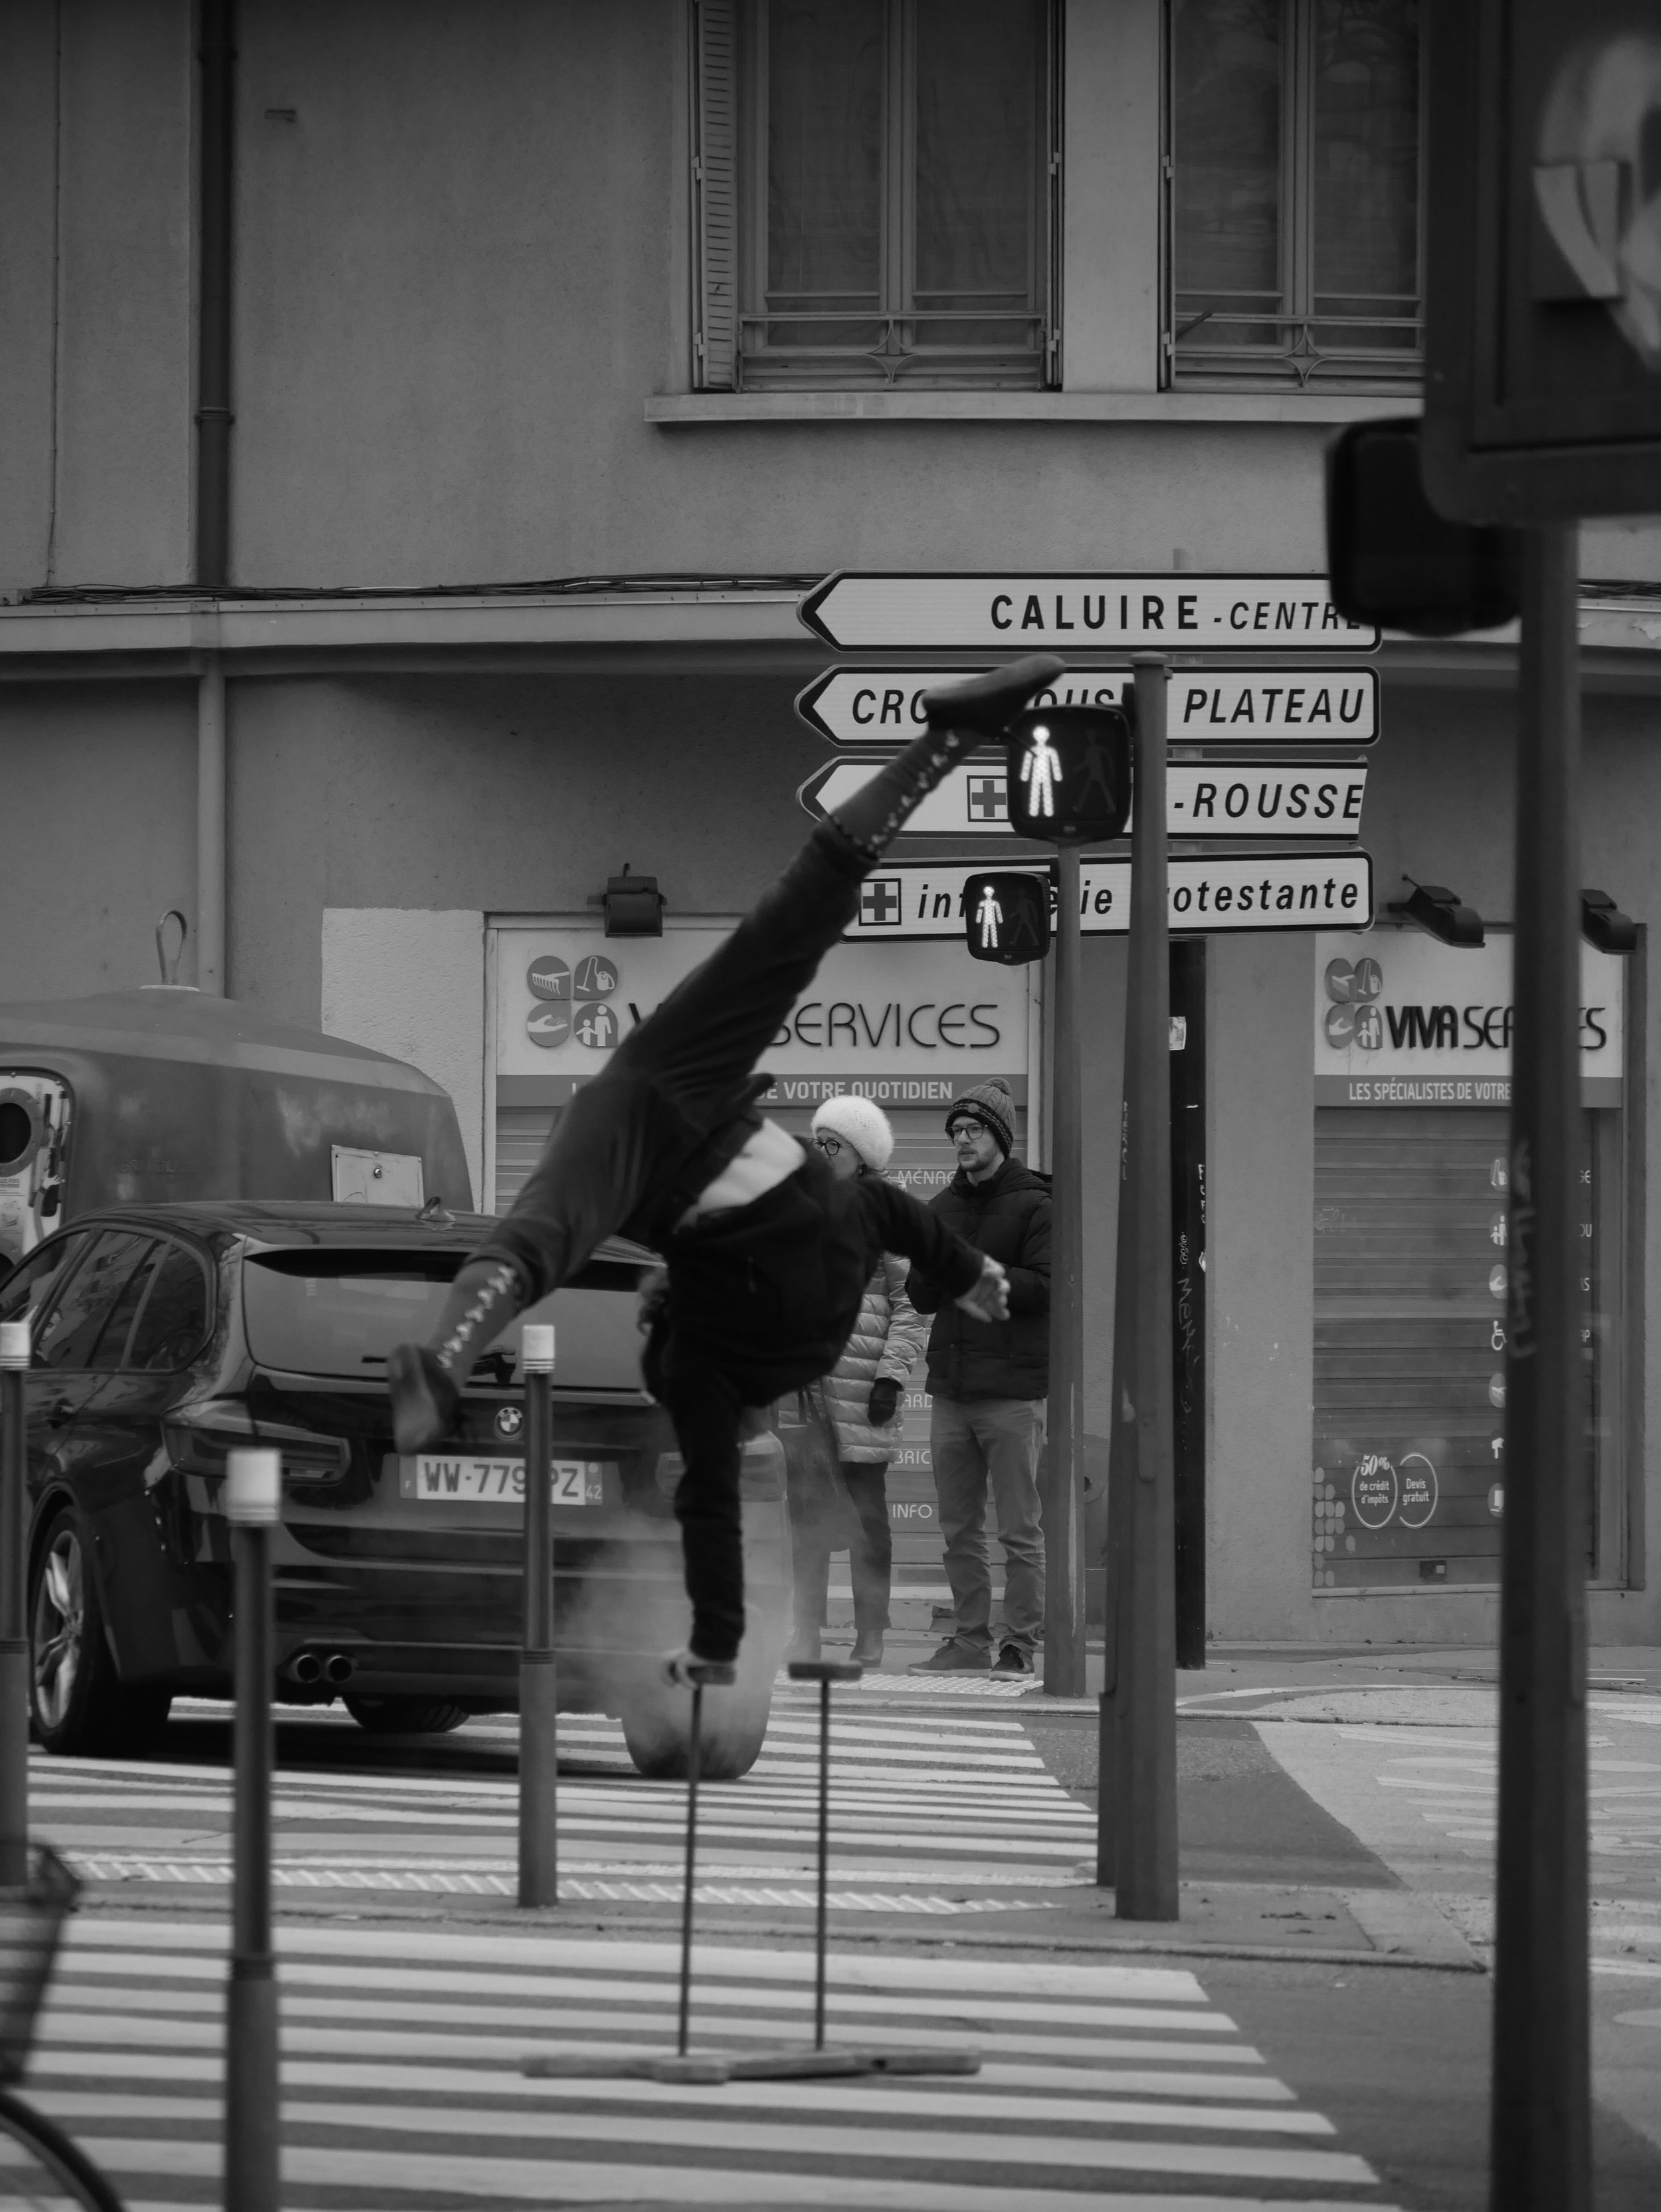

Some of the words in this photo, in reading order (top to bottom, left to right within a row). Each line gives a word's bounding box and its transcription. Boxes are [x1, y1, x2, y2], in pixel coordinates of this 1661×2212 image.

[991, 594, 1199, 631] CALUIRE
[1183, 688, 1365, 724] PLATEAU
[1173, 783, 1364, 819] -ROUSSE
[1167, 878, 1358, 912] otestante
[851, 1081, 953, 1100] QUOTIDIEN
[1349, 1082, 1371, 1100] LES
[1374, 1076, 1454, 1100] SPÉCIALISTES
[1457, 1082, 1472, 1100] DE
[1475, 1082, 1512, 1100] VOTRE
[1360, 1455, 1391, 1476] 50%
[586, 1484, 602, 1500] 42
[1359, 1480, 1369, 1492] de
[1369, 1479, 1390, 1492] crédit
[1406, 1478, 1426, 1490] Devis
[1403, 1490, 1430, 1506] gratuit
[893, 1504, 933, 1519] INFO
